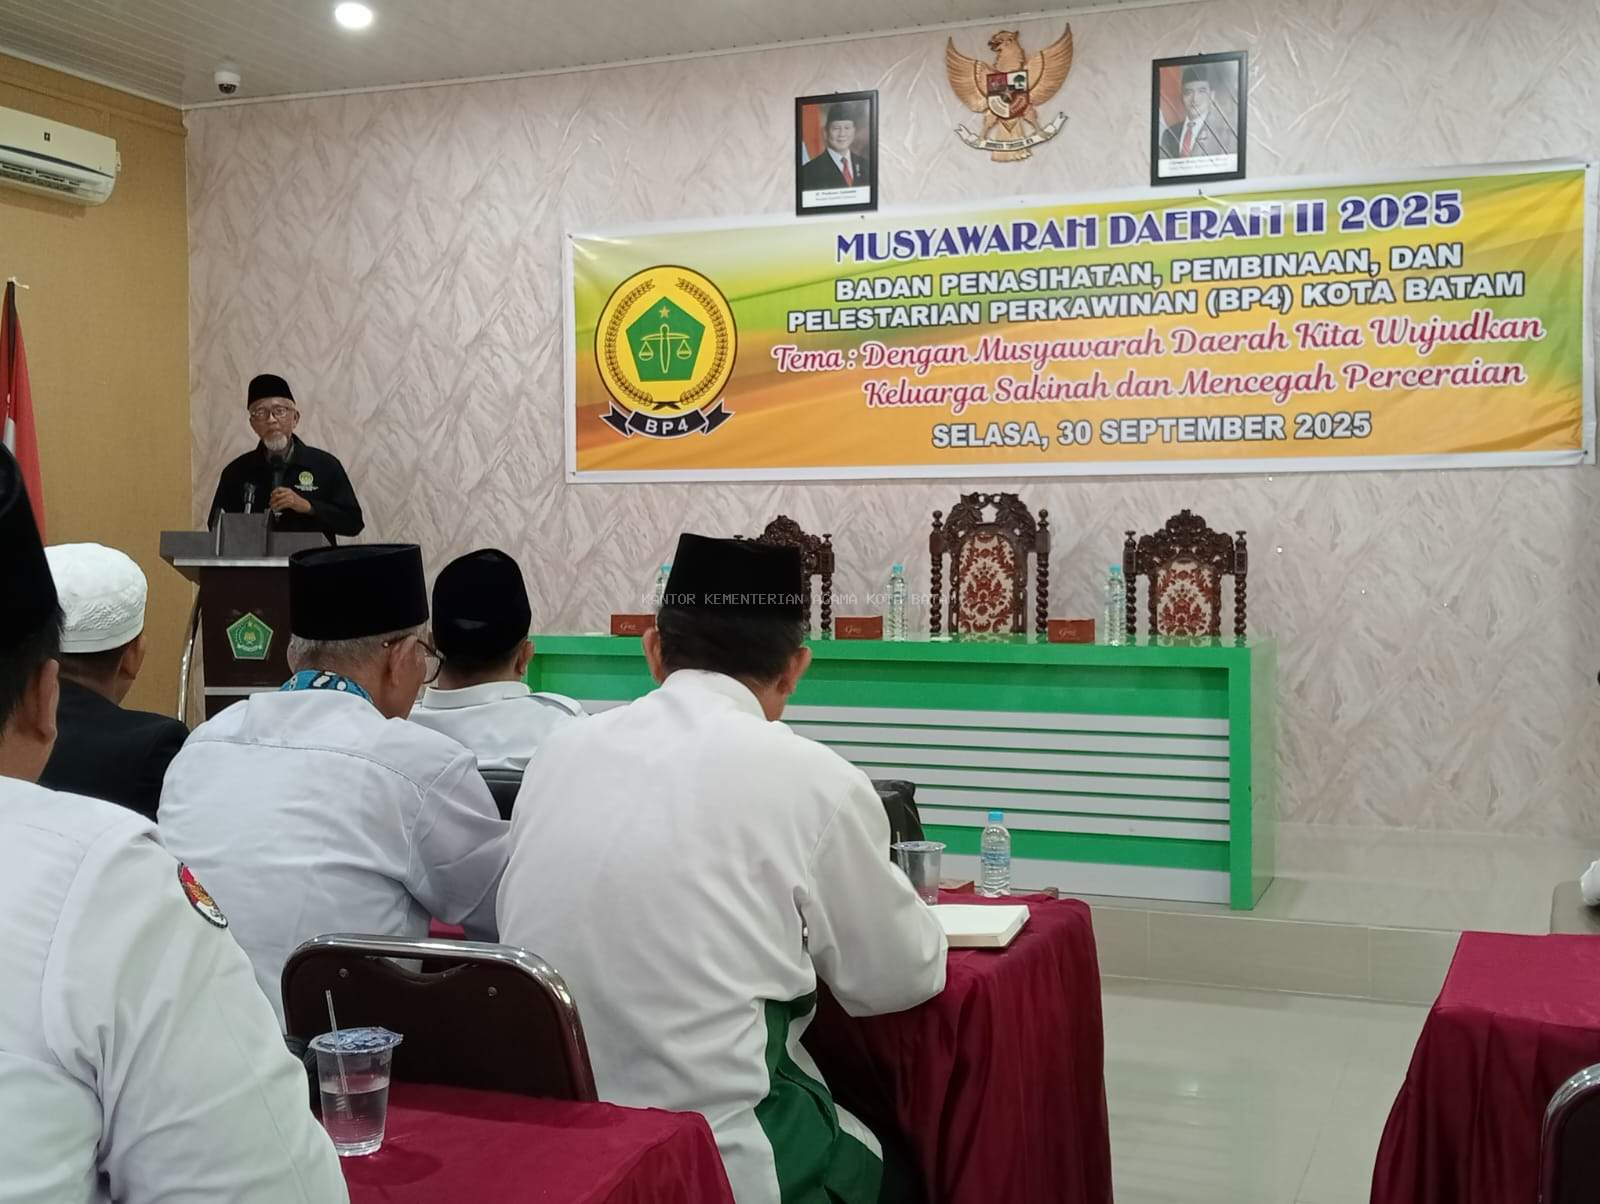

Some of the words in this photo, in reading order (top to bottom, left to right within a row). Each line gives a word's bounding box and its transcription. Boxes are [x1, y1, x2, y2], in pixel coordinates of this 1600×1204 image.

[835, 215, 1098, 263] MUSYAWARAH
[1108, 201, 1283, 246] DAERAH
[1295, 201, 1325, 232] II
[1340, 192, 1462, 230] 2025
[787, 301, 981, 333] PELESTARIAN
[989, 291, 1197, 323] PERKAWINAN
[1206, 284, 1293, 317] (BP4)
[1302, 278, 1395, 308] KOTA
[1404, 271, 1525, 301] BATAM
[835, 275, 932, 302] BADAN
[940, 261, 1162, 297] PENASIHATAN,
[1171, 248, 1380, 284] PEMBINAAN,
[1389, 242, 1463, 271] DAN
[861, 341, 968, 376] Dengan
[972, 327, 1164, 371] Musyawarah
[1169, 320, 1289, 356] Daerah
[1293, 319, 1363, 350] Kita
[1369, 309, 1545, 358] Wujudkan
[863, 377, 988, 415] Keluarga
[993, 371, 1111, 403] Sakinah
[1115, 369, 1174, 399] dan
[1178, 361, 1336, 404] Mencegah
[1341, 358, 1526, 393] Perceraian
[645, 417, 689, 436] BP4
[931, 421, 1049, 450] SELASA,
[1056, 420, 1093, 446] 30
[1099, 413, 1286, 445] SEPTEMBER
[1294, 411, 1372, 440] 2025
